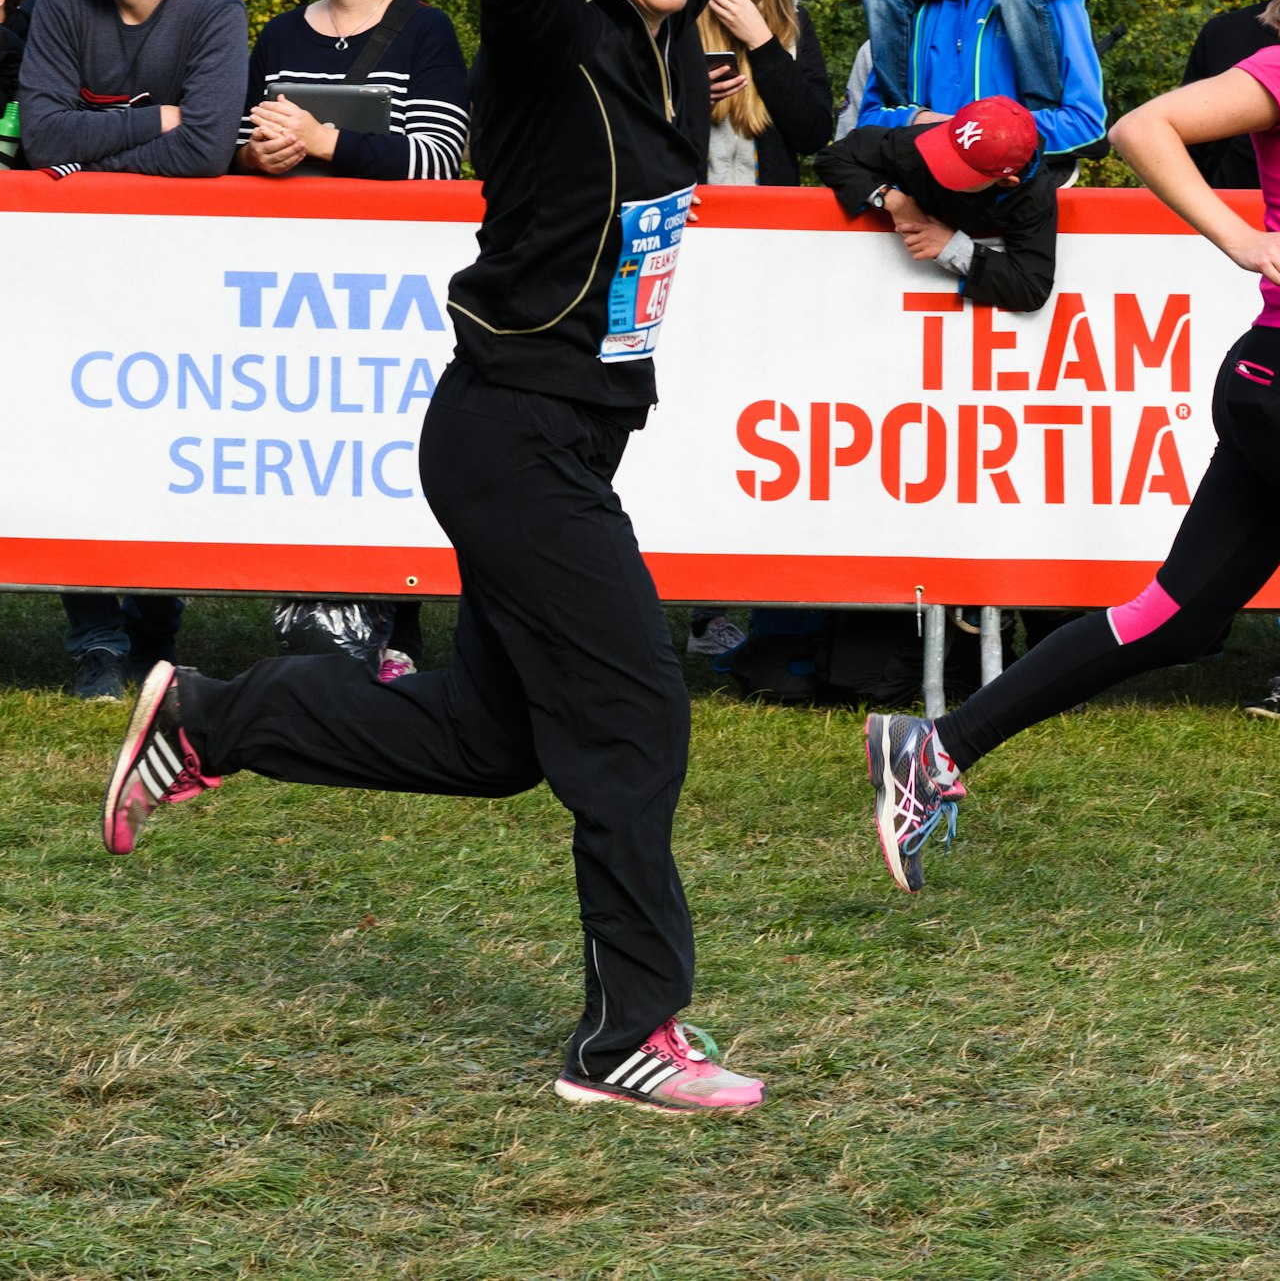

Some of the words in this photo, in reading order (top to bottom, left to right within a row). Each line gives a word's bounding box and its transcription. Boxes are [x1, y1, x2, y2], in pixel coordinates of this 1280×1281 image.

[632, 236, 660, 253] TATA
[650, 253, 670, 271] TEAM
[224, 271, 446, 331] TATA
[646, 278, 671, 319] 45
[903, 292, 1191, 393] TEAM
[168, 436, 423, 500] SERVIC
